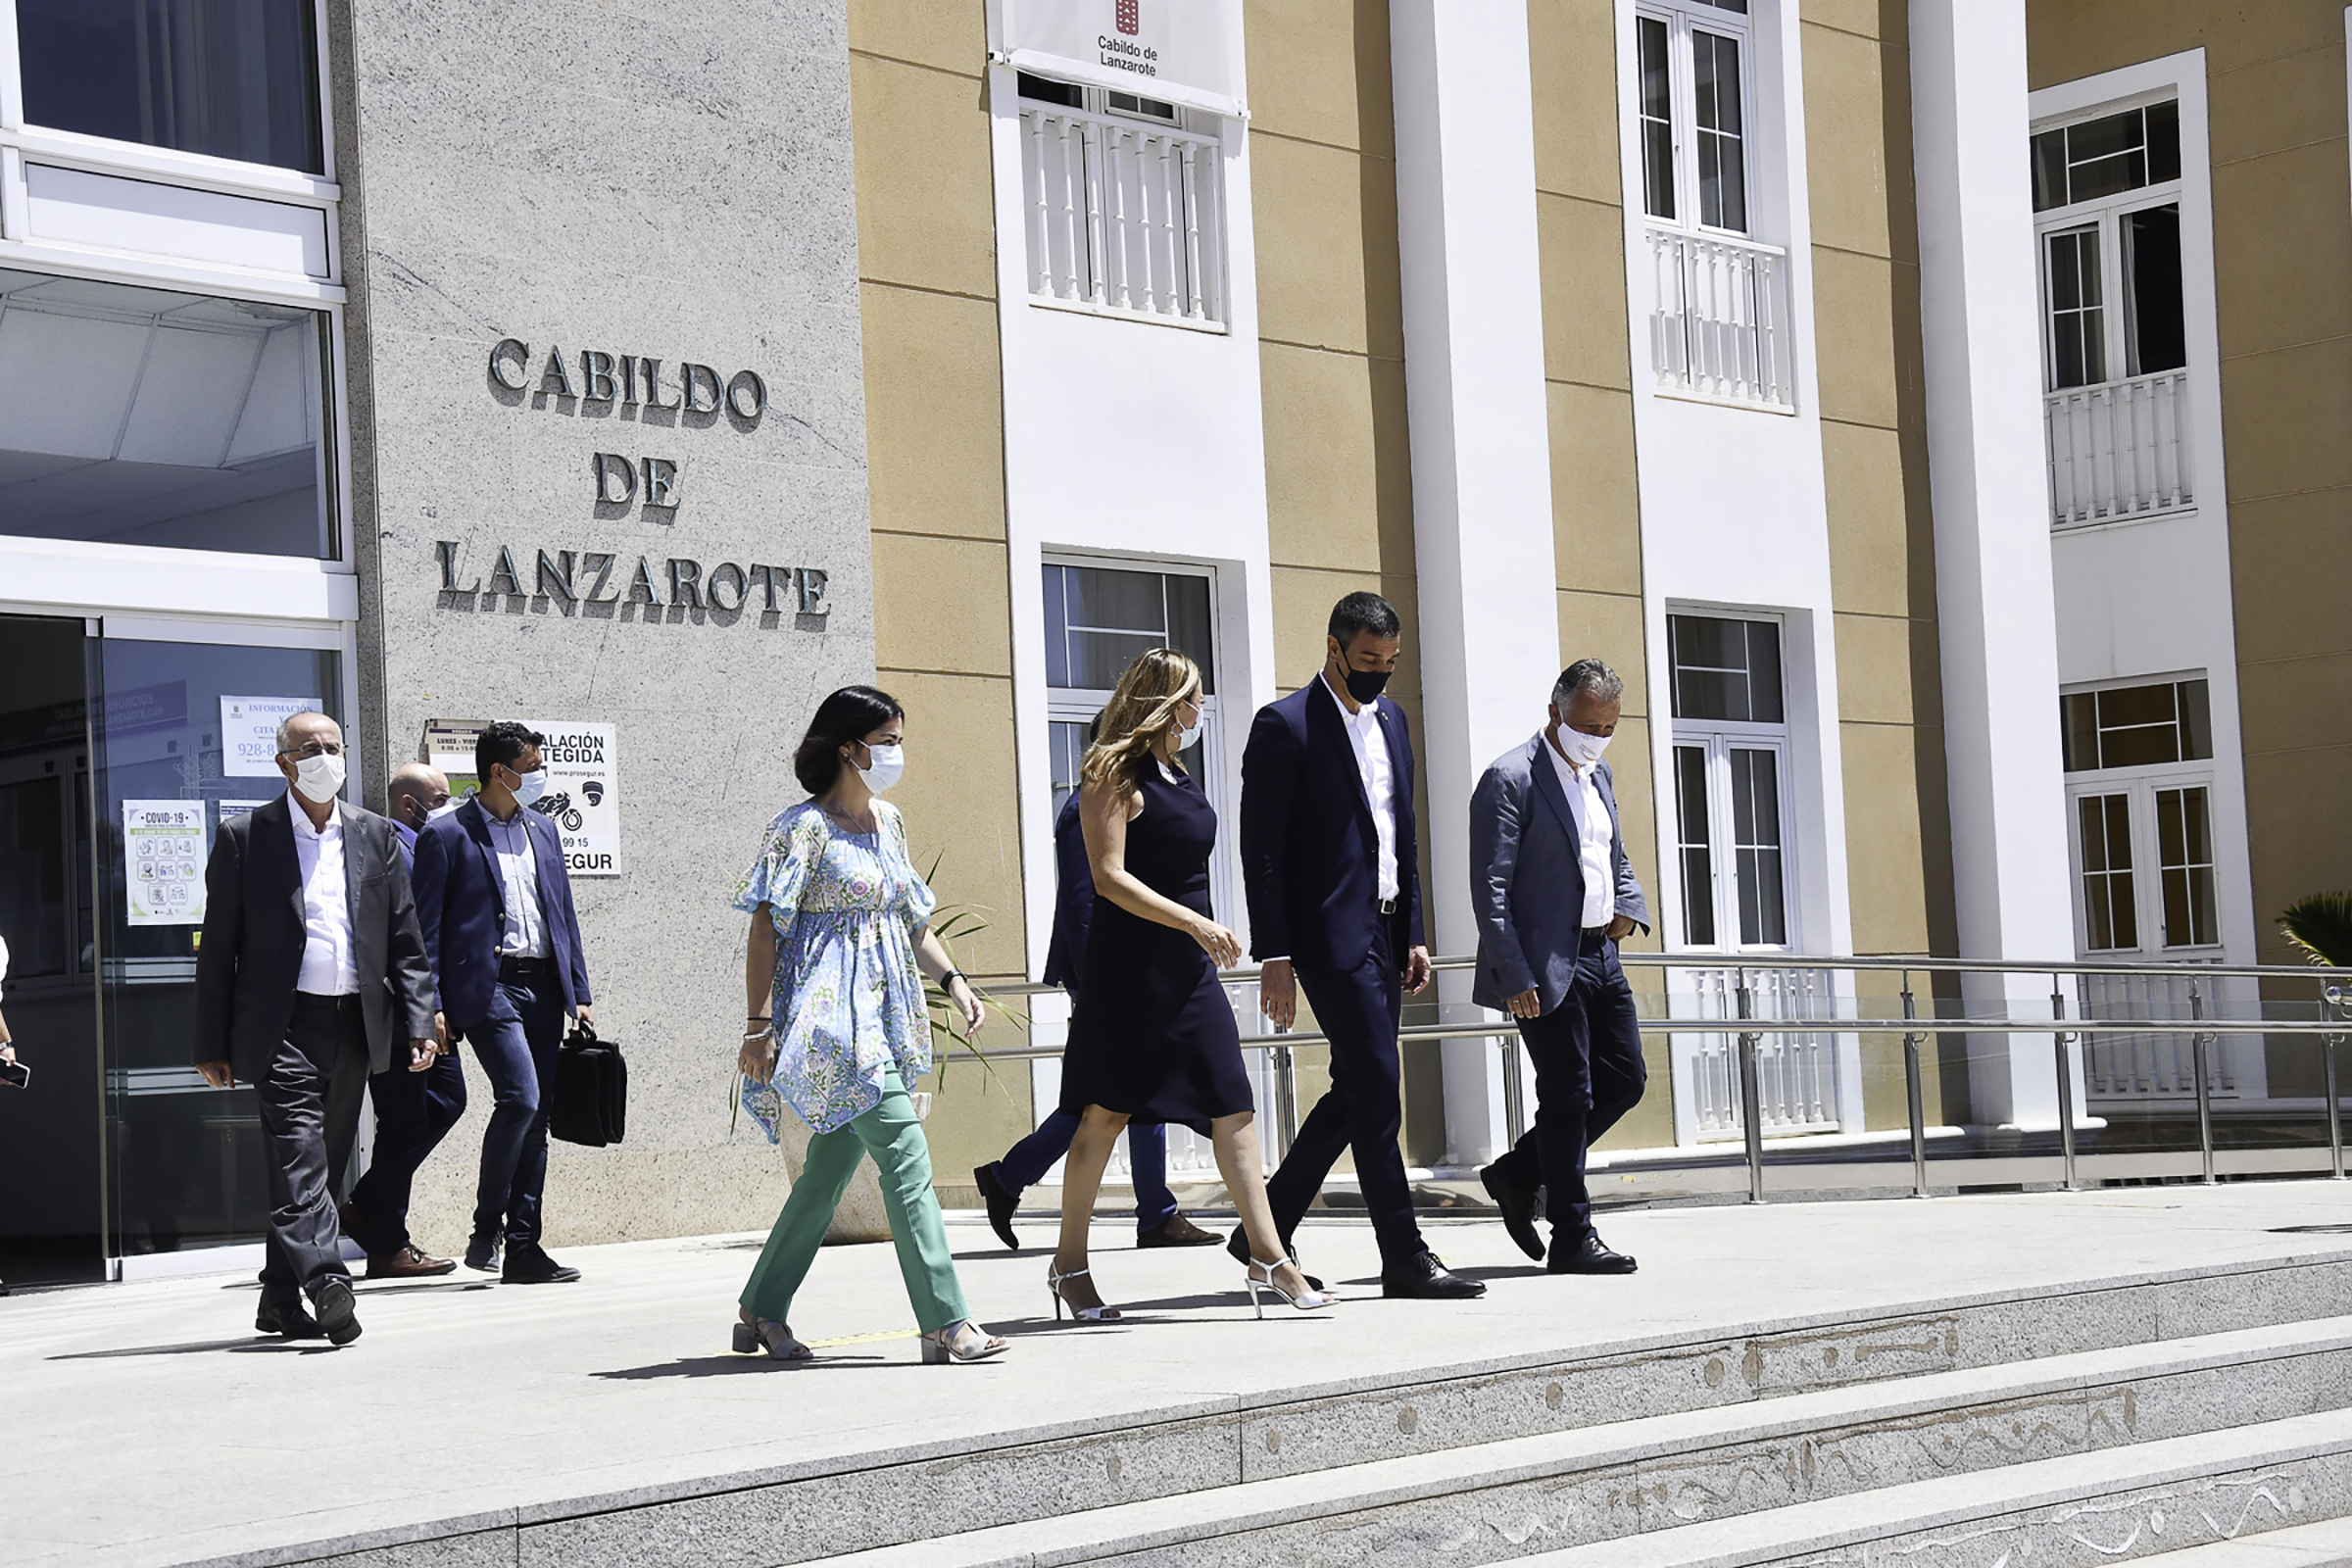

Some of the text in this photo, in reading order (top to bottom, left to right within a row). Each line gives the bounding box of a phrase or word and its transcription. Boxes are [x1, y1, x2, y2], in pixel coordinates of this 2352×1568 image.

[1098, 35, 1158, 61] Cabildo de
[1101, 51, 1156, 76] Lanzarote
[489, 338, 767, 419] CABILDO
[593, 452, 682, 510] DE
[435, 540, 832, 616] LANZAROTE
[106, 693, 154, 712] ANUNCIOS
[541, 731, 604, 749] ALACIÓN
[237, 742, 275, 757] 928-8
[541, 748, 605, 763] TEGIDA
[146, 812, 184, 823] COVID-19
[563, 837, 589, 848] 99 15
[564, 854, 612, 869] EGUR
